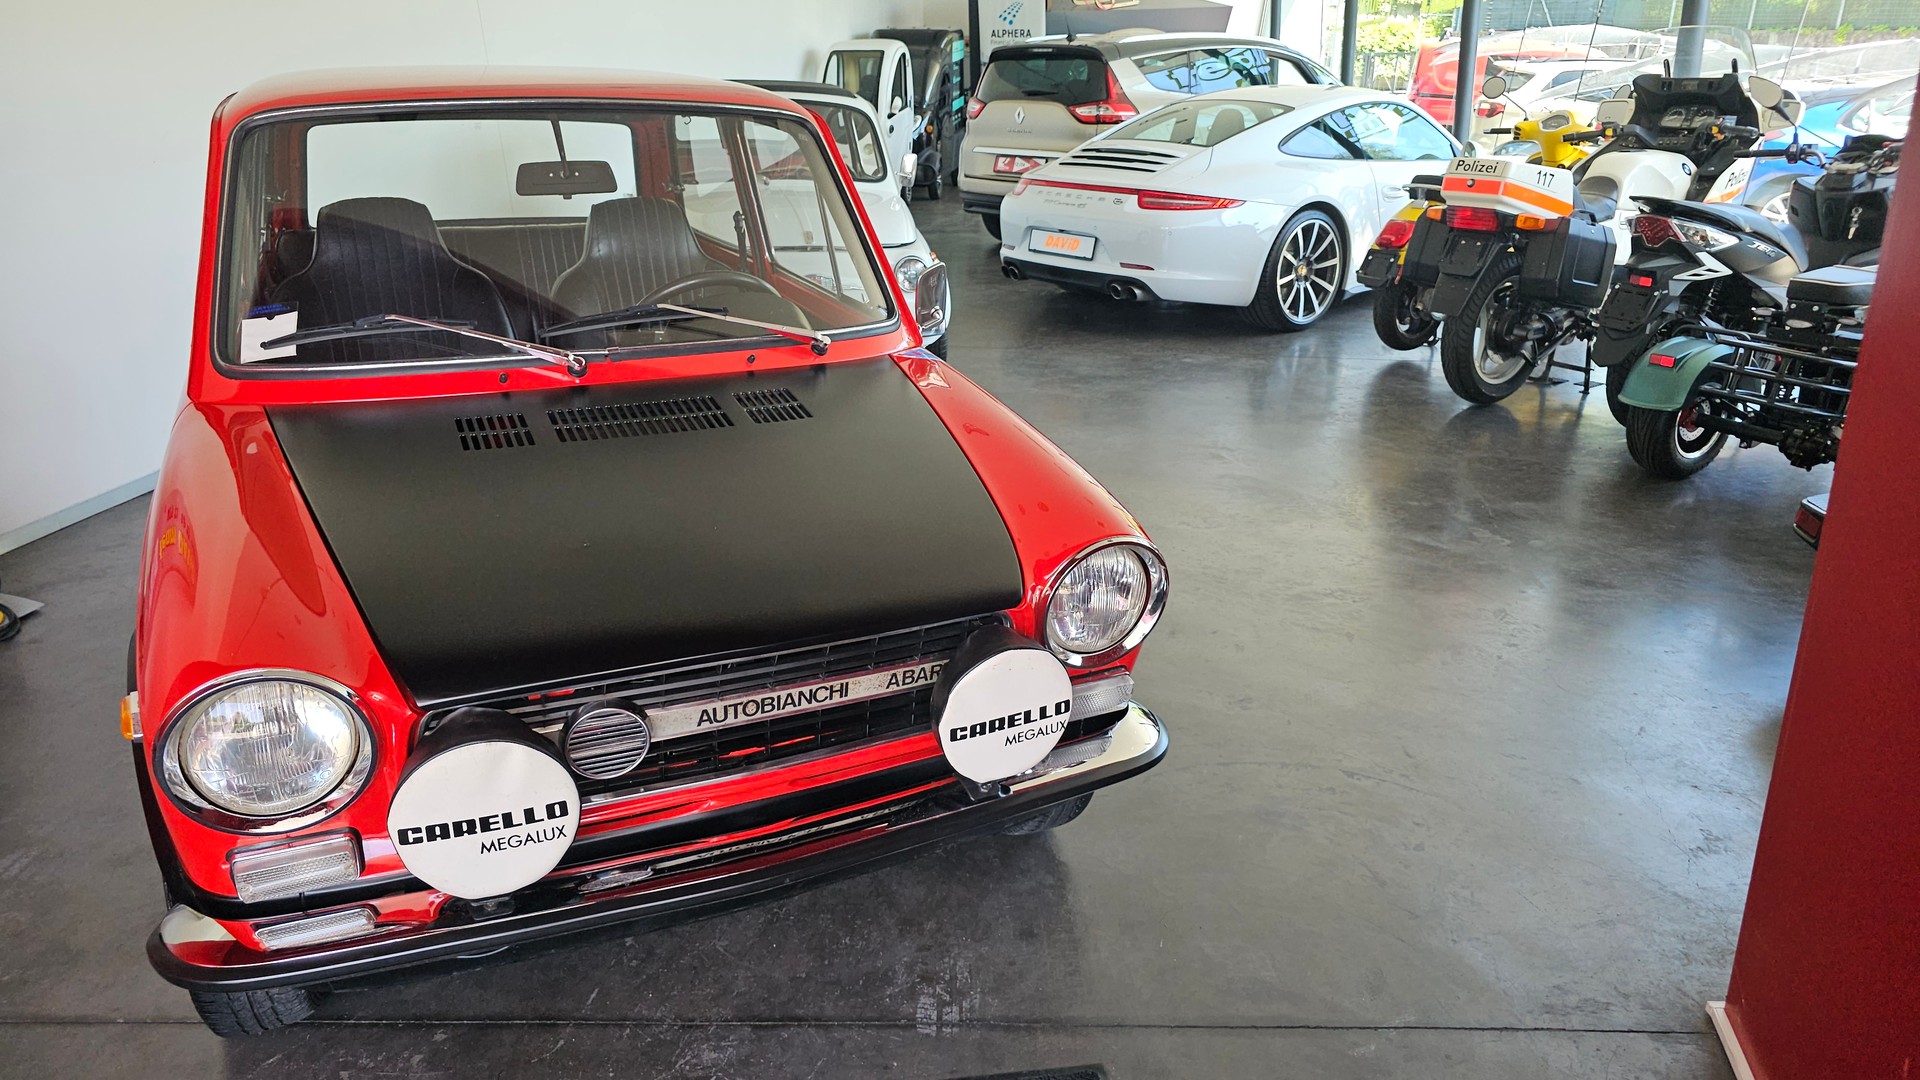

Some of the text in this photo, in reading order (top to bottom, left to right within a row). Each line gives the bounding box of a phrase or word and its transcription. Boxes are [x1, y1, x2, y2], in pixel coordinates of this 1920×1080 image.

[991, 29, 1032, 38] ALPHERA
[1455, 160, 1499, 174] Polizei
[1536, 170, 1555, 188] 117
[696, 663, 943, 728] AUTOBIANCHI ABAR
[949, 699, 1071, 743] CARELLO
[1004, 719, 1067, 747] MEGALUX
[397, 800, 569, 846] CARELLO
[480, 824, 567, 855] MEGALUX
